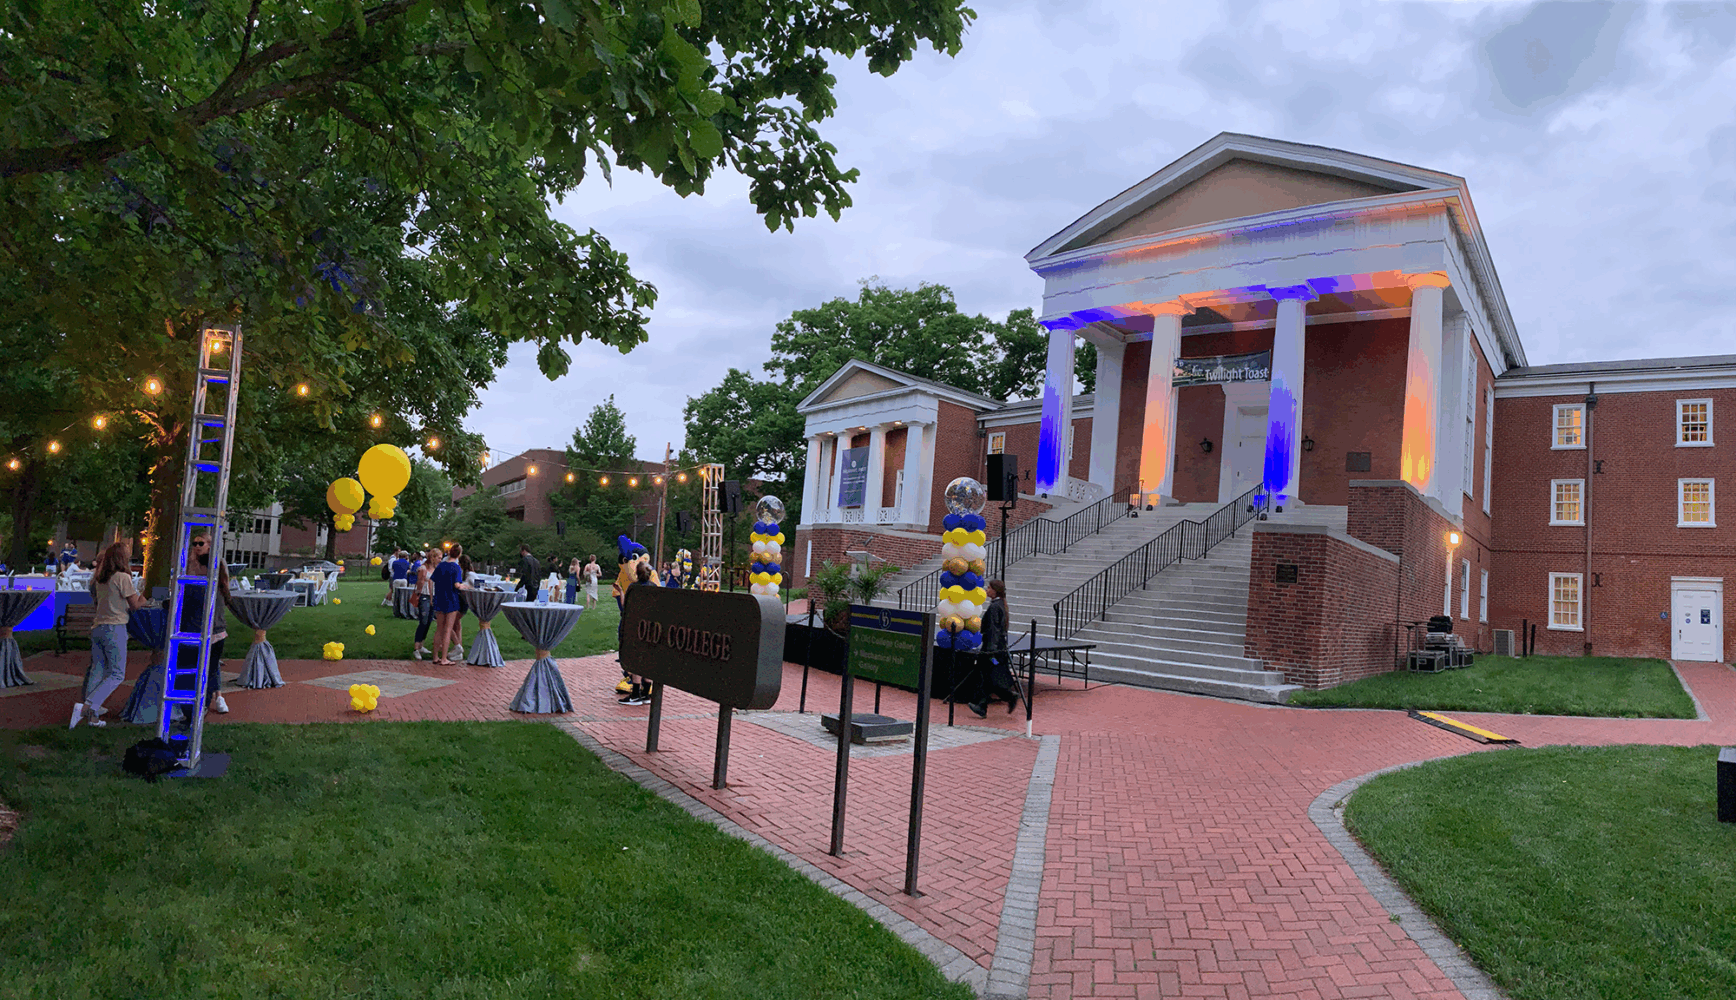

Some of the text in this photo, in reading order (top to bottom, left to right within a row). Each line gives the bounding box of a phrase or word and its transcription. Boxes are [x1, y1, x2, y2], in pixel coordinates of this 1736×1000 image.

[1205, 367, 1242, 383] Twilight
[1244, 366, 1269, 379] Toast
[637, 619, 731, 661] OLD COLLEGE
[894, 639, 916, 652] Gallery
